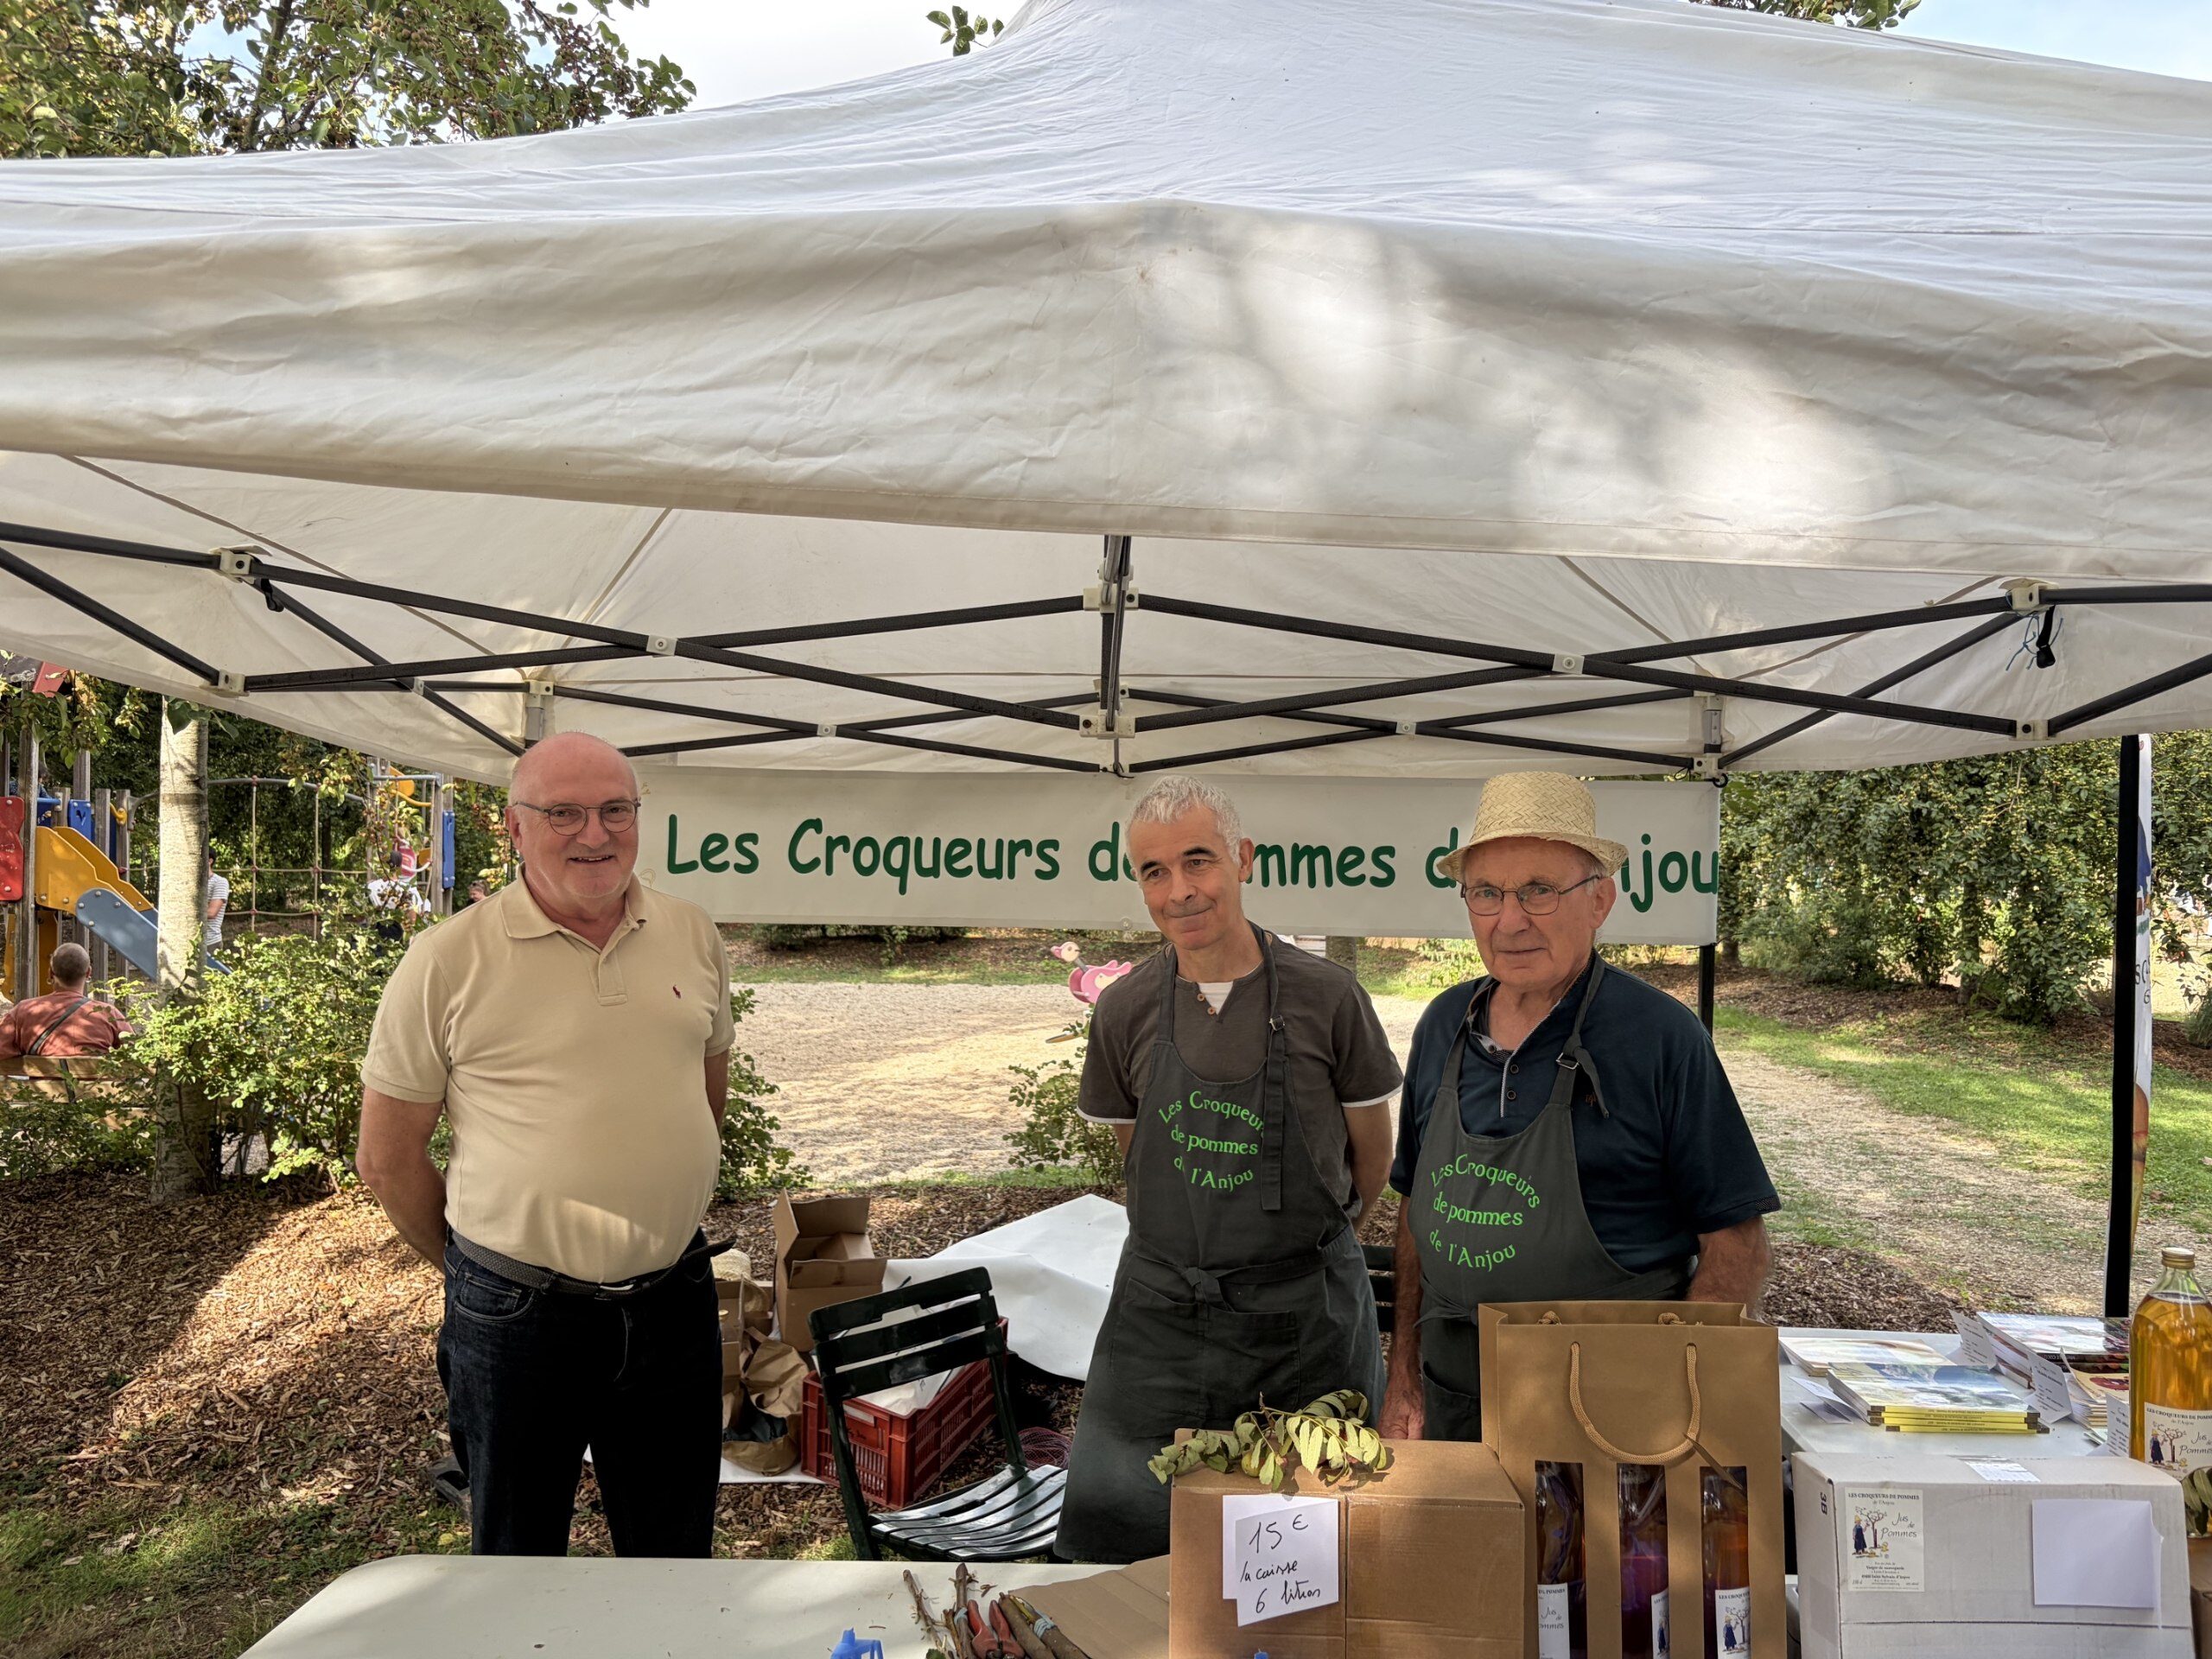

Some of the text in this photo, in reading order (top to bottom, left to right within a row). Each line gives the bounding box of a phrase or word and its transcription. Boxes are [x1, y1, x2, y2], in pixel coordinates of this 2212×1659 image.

[666, 813, 760, 874] Les
[787, 817, 1060, 896] Croqueurs
[1425, 826, 1459, 889] d
[1158, 1090, 1264, 1135] Les Croqueur
[1171, 1124, 1258, 1155] de pommes
[1173, 1155, 1254, 1192] d l'Anjou
[1455, 1154, 1541, 1209] Croqueurs
[1433, 1191, 1523, 1226] de pommes
[1429, 1229, 1516, 1272] de l'Anjou
[1249, 1514, 1309, 1554] 15 €
[1881, 1527, 1917, 1540] Pommes
[1891, 1512, 1909, 1526] Jus
[1255, 1588, 1268, 1614] 6
